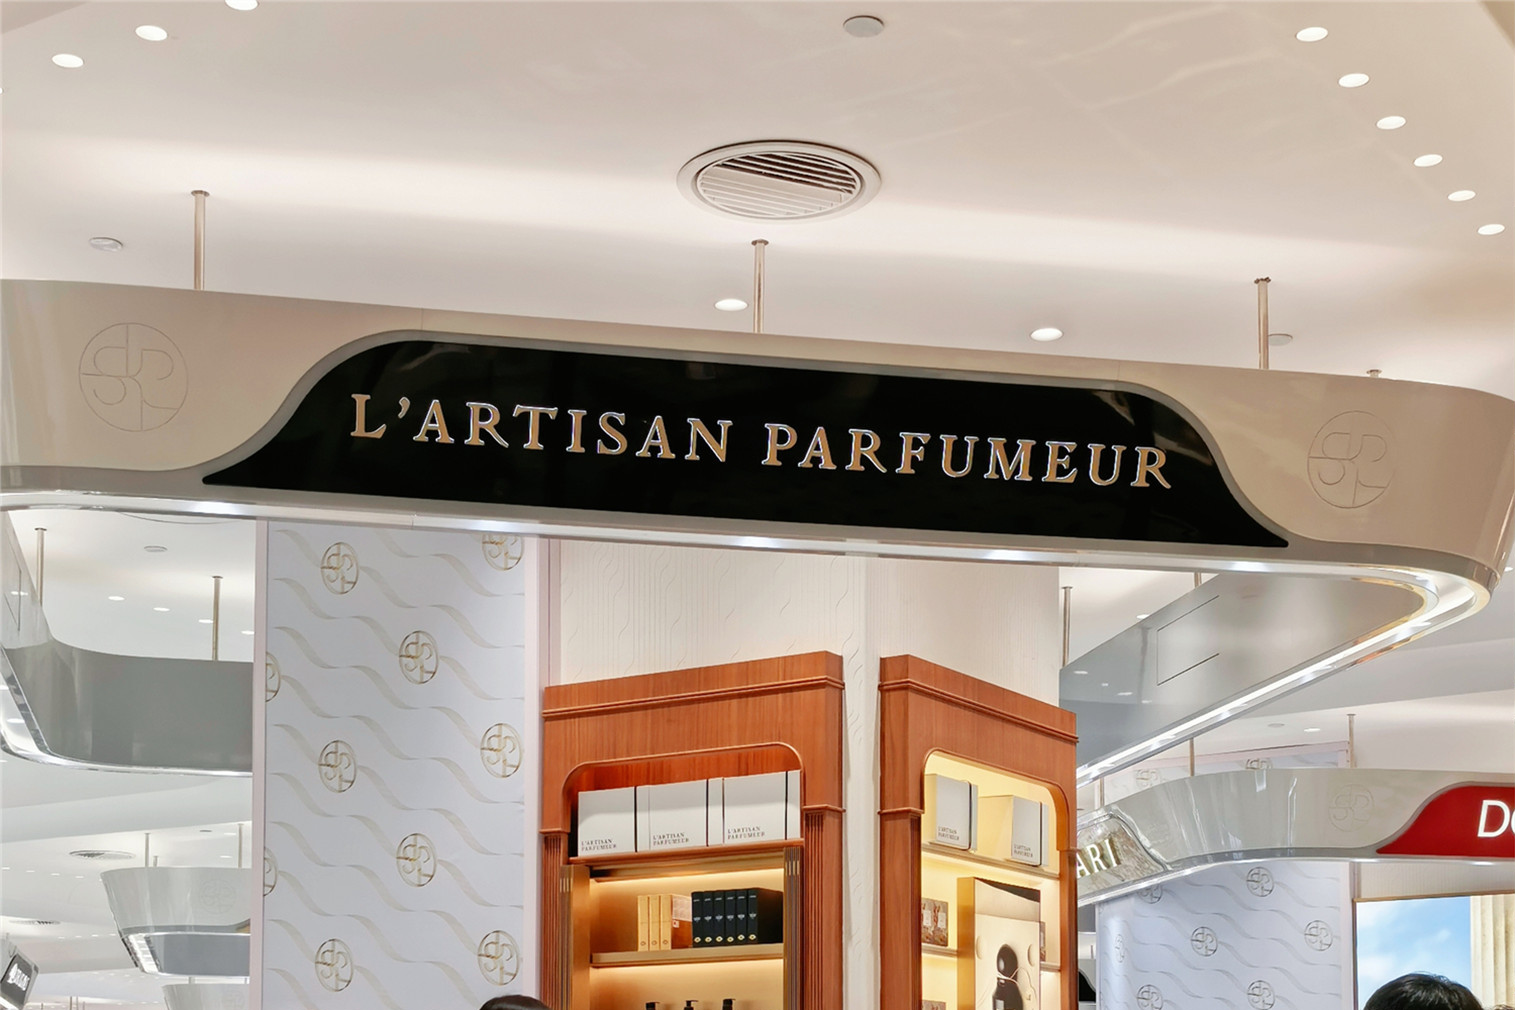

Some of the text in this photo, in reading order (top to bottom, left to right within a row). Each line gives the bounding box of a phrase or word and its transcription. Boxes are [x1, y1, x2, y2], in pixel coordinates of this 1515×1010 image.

[350, 393, 1172, 489] L'ARTISAN PARFUMEUR
[1477, 799, 1514, 838] D
